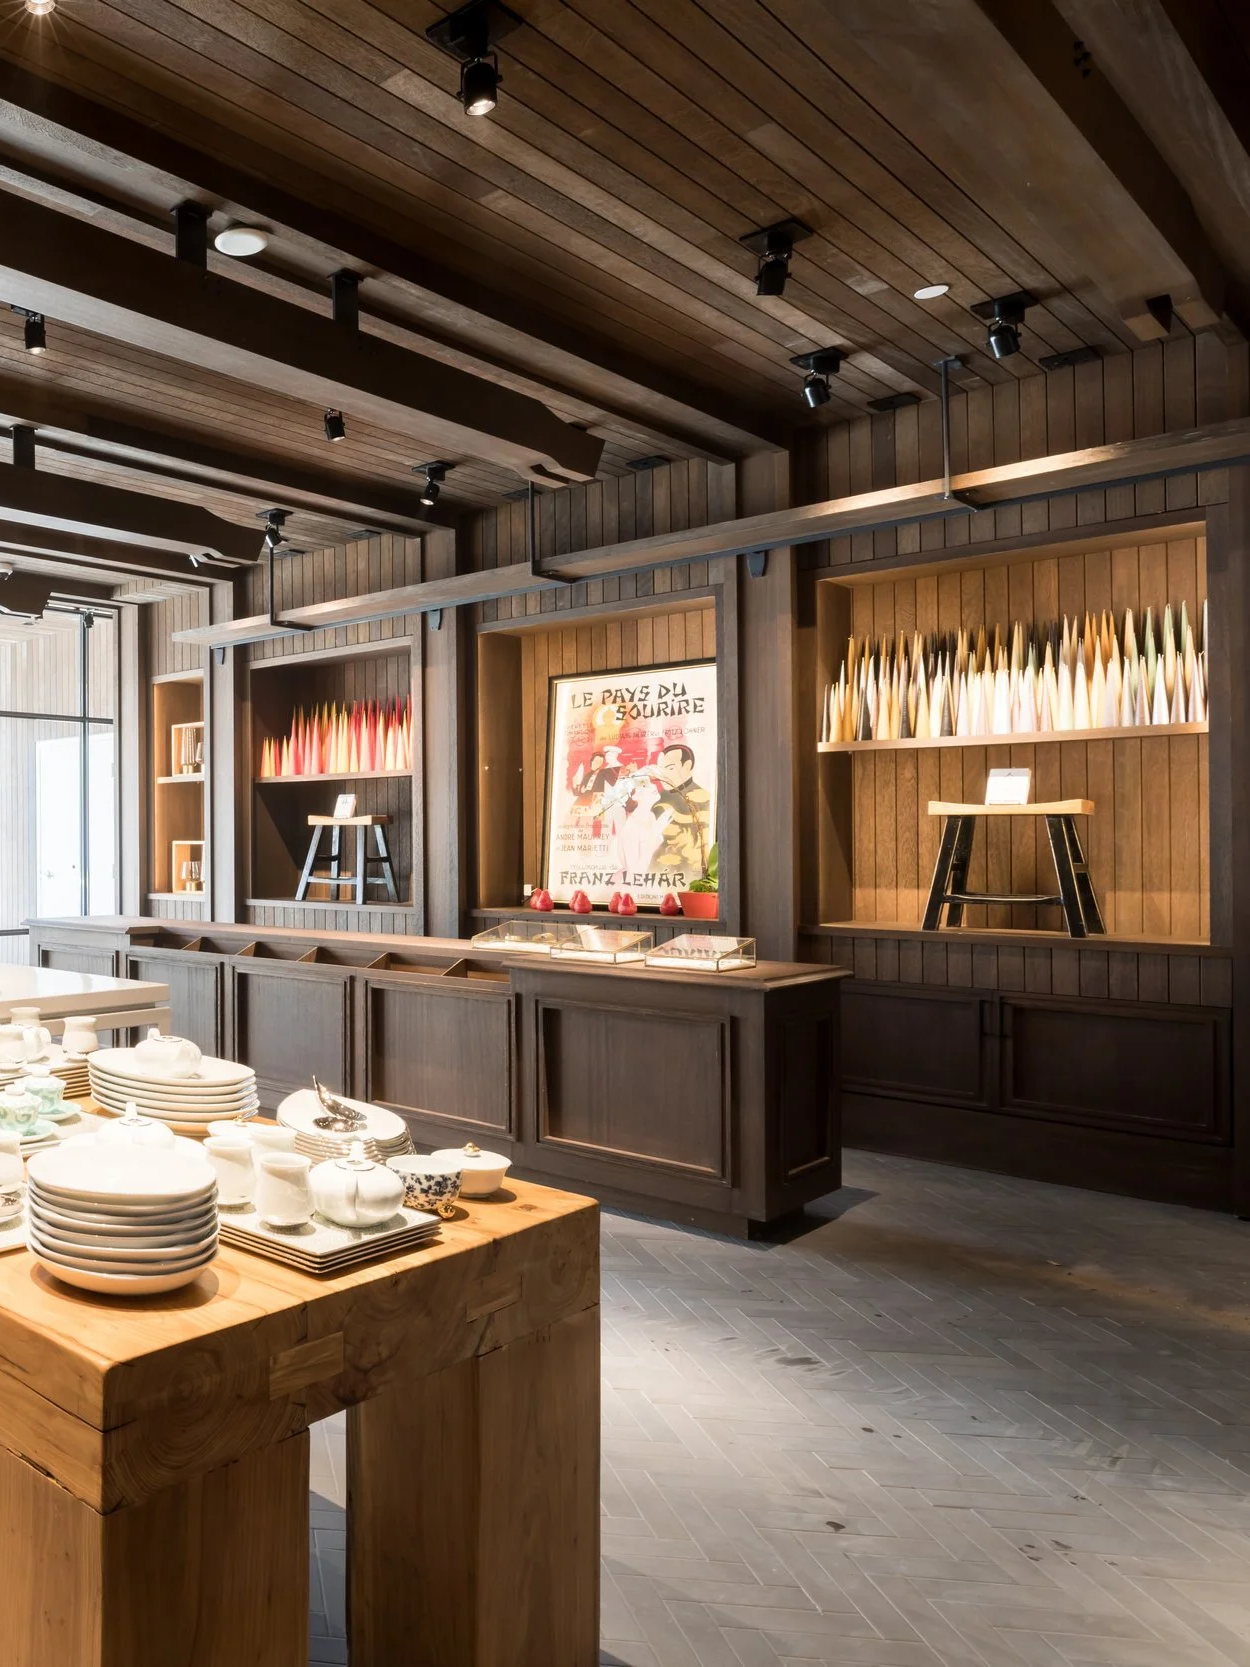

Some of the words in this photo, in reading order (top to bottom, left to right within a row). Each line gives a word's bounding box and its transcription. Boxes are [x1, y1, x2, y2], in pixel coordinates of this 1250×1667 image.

[571, 692, 593, 709] LE
[601, 685, 650, 705] PAYS
[657, 682, 687, 700] DU
[559, 870, 616, 886] FRANZ
[621, 868, 687, 888] LEHÁR
